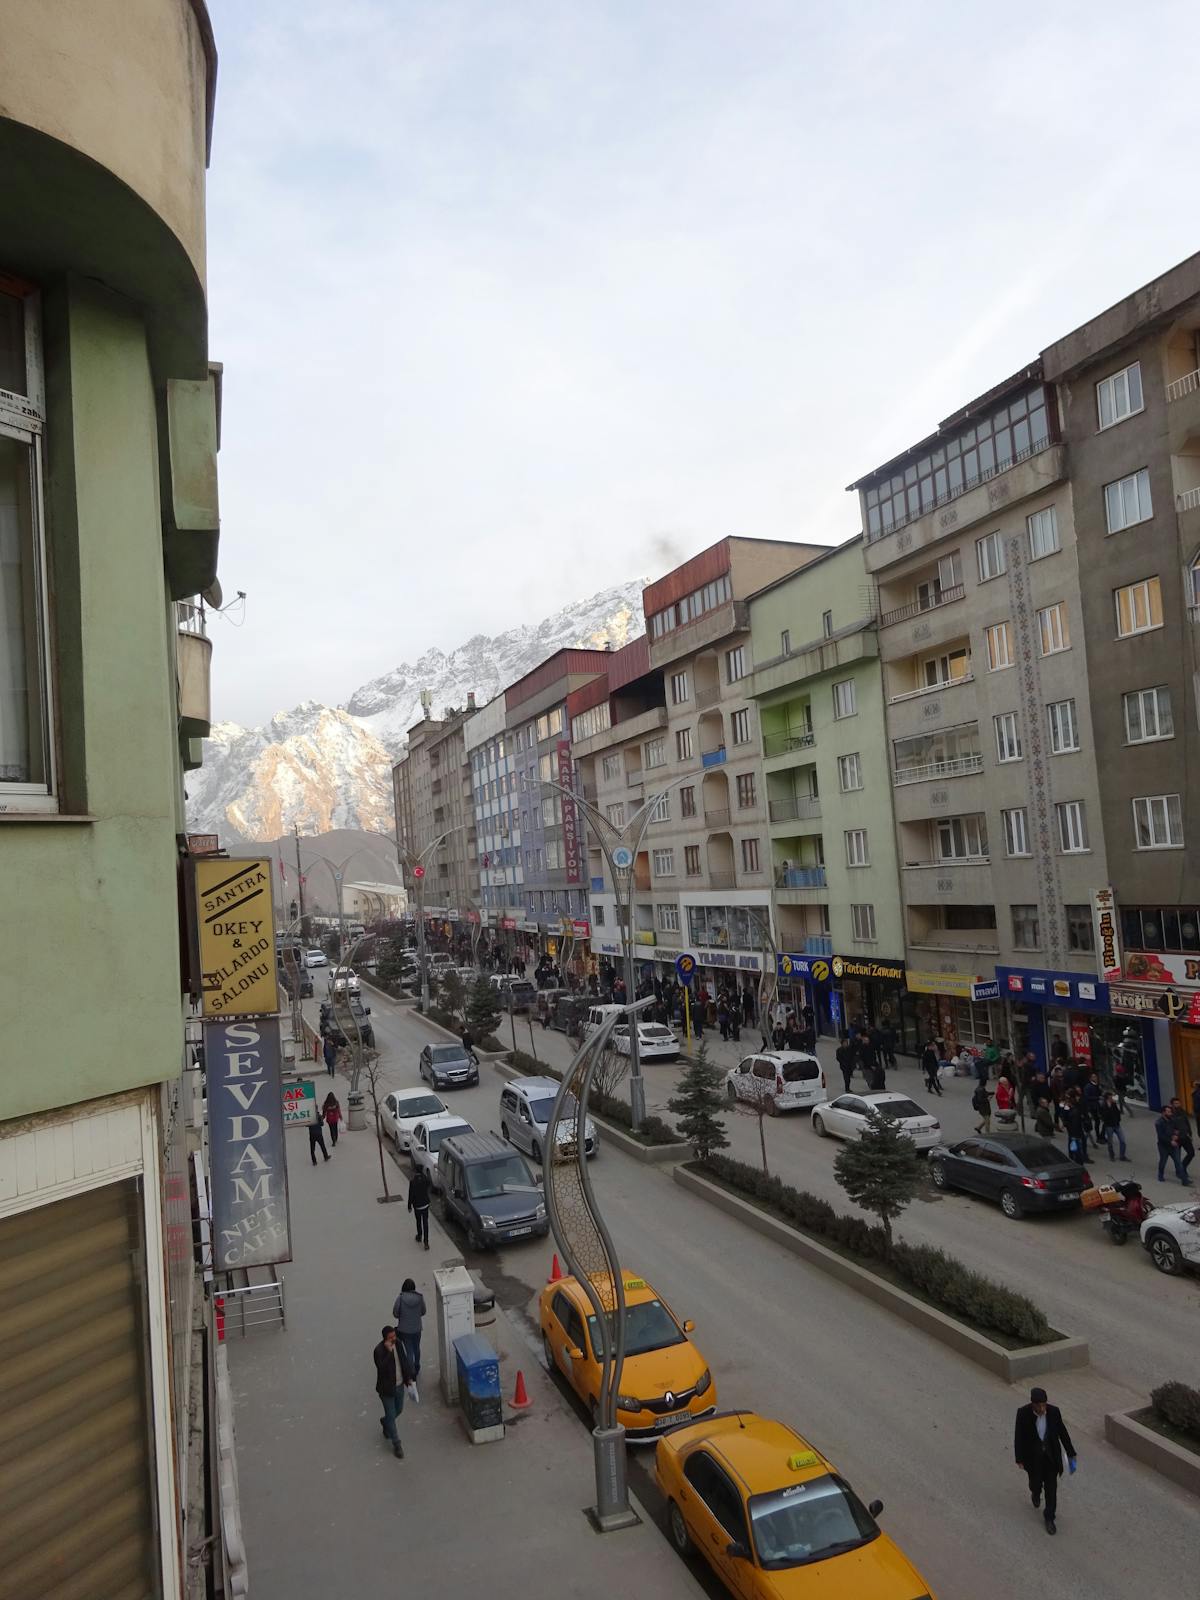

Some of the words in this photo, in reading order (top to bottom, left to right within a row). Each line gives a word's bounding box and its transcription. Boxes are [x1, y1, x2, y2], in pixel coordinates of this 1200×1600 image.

[205, 872, 266, 911] SANTRA
[213, 921, 263, 936] OKEY
[232, 938, 242, 948] &
[212, 963, 269, 1010] SALONU
[975, 985, 998, 997] mavi
[1110, 991, 1153, 1010] Piroğlu
[223, 1022, 275, 1204] SEVDAM
[221, 1203, 276, 1244] NET
[224, 1222, 286, 1265] CAFE
